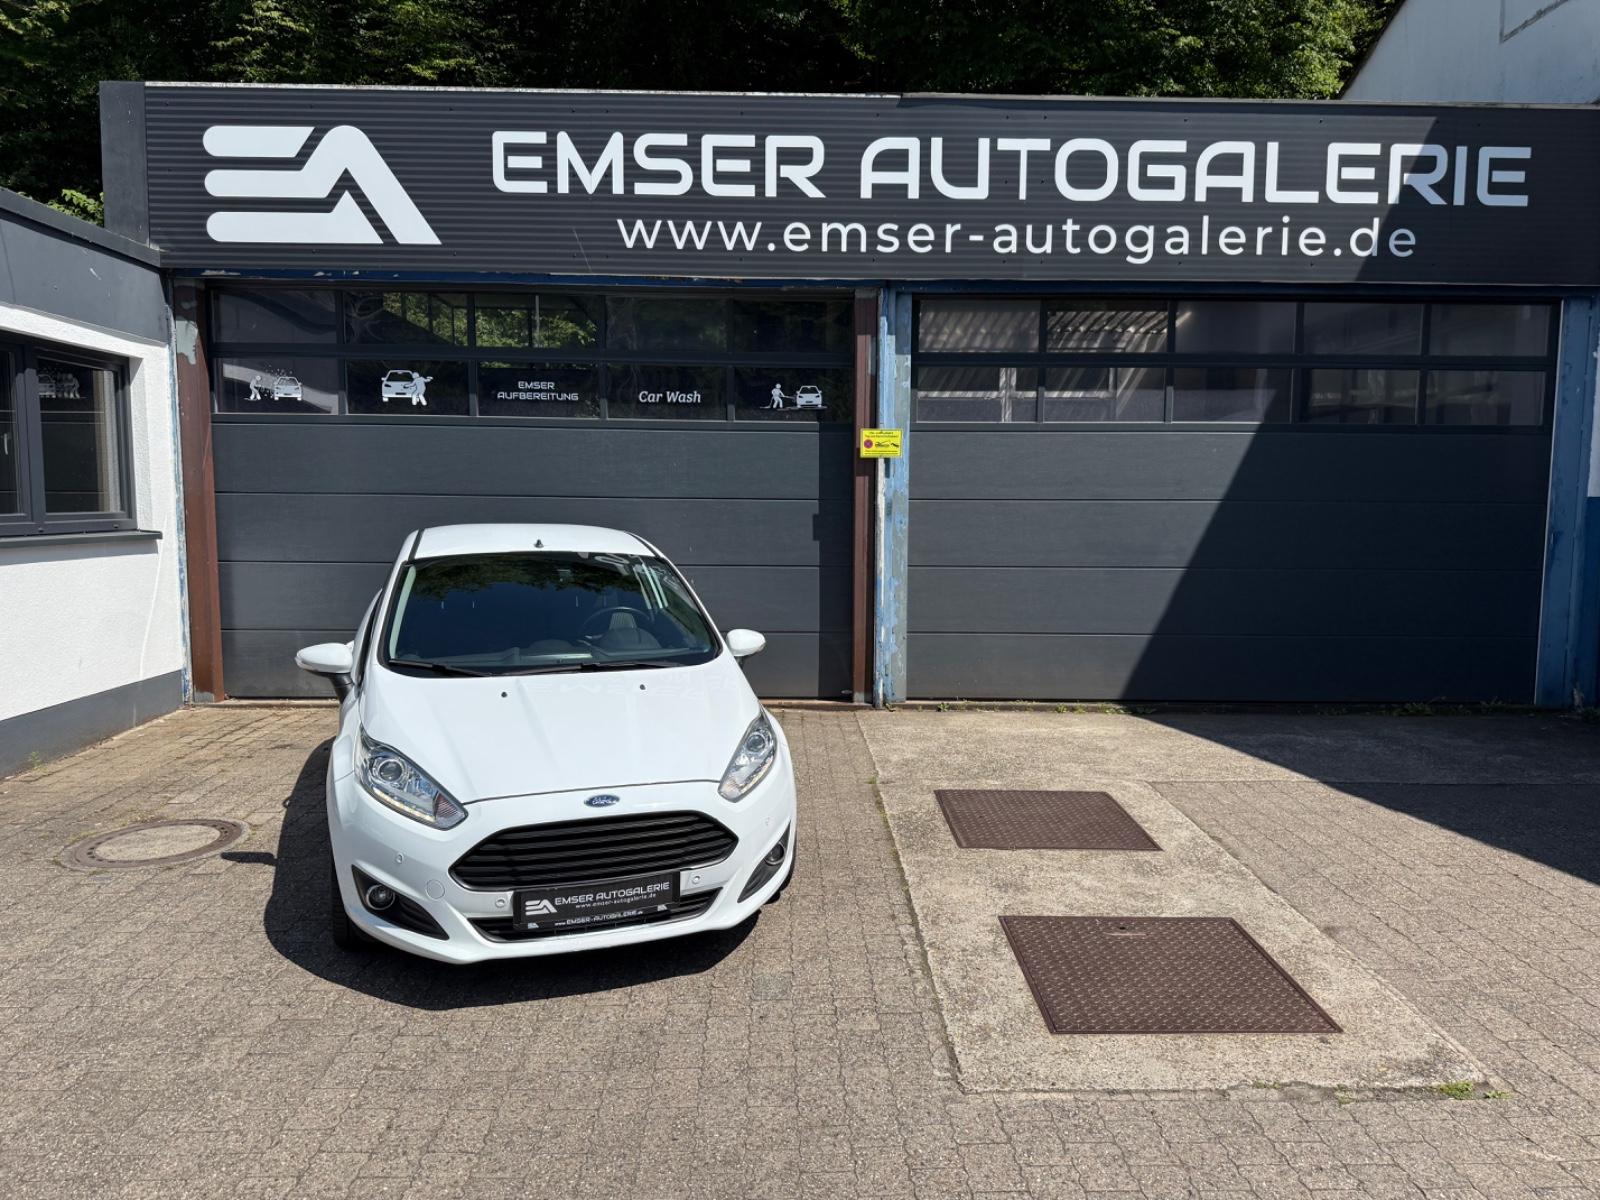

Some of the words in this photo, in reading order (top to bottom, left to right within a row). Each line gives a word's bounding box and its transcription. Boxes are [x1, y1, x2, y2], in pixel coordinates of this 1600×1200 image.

[491, 130, 826, 199] EMSER
[859, 136, 1532, 208] AUTOGALERIE
[616, 214, 1417, 265] www.emser-autogalerie.de
[518, 381, 556, 390] EMSER
[497, 391, 579, 401] AUFBEREITUNG
[638, 390, 663, 403] Car
[665, 390, 701, 403] Wash
[554, 893, 594, 906] EMSER
[595, 881, 671, 901] AUTOGALERIE
